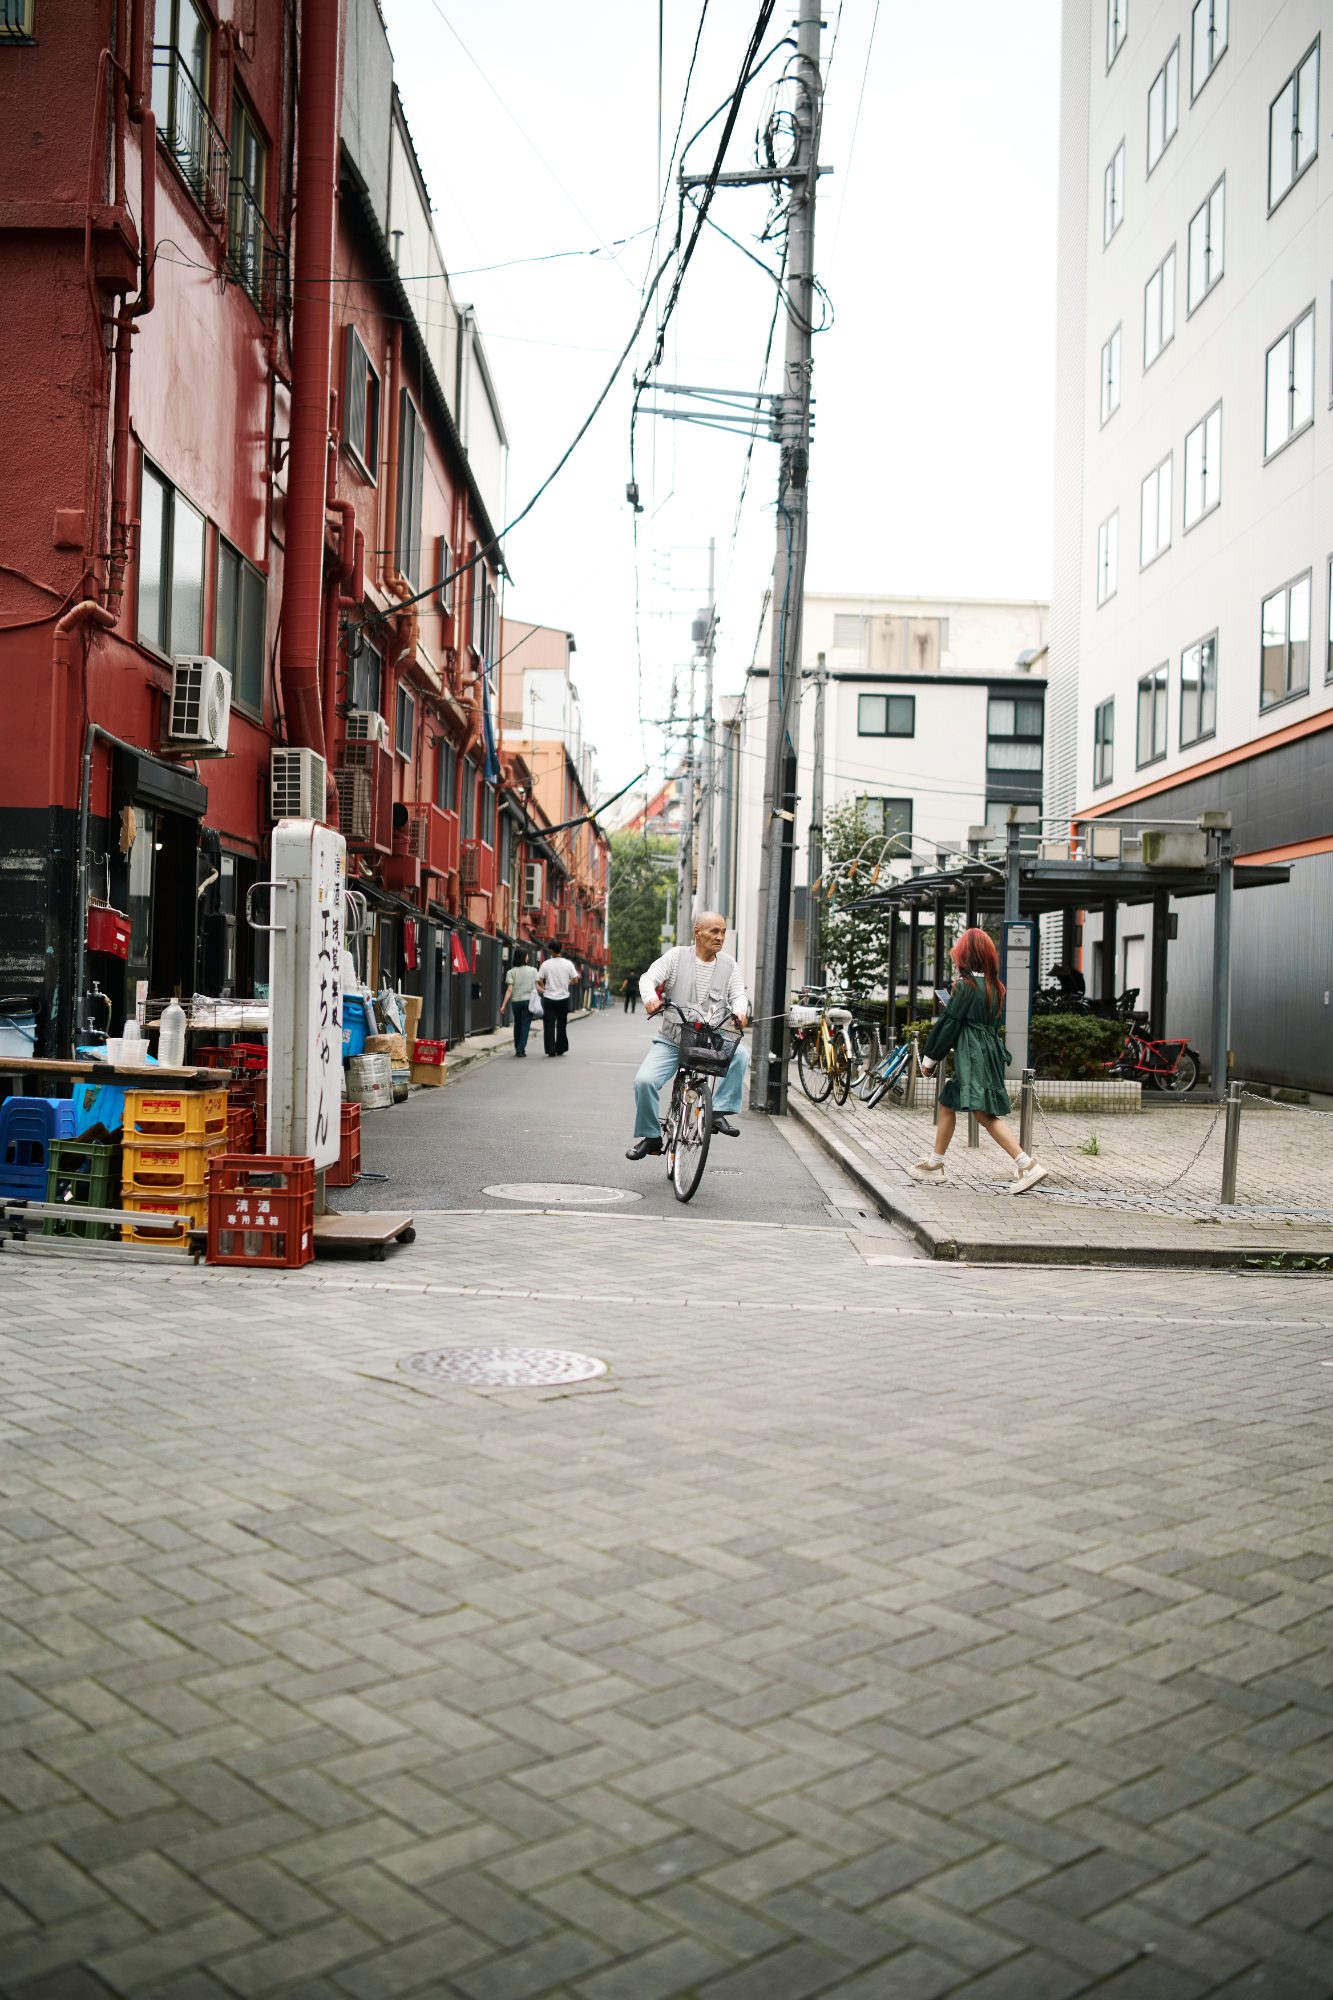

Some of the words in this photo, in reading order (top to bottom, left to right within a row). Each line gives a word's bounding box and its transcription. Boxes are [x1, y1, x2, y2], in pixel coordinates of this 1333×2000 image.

[315, 909, 331, 1147] 正ちゃん
[236, 1199, 271, 1213] 清酒
[227, 1214, 279, 1226] 専用通箱
